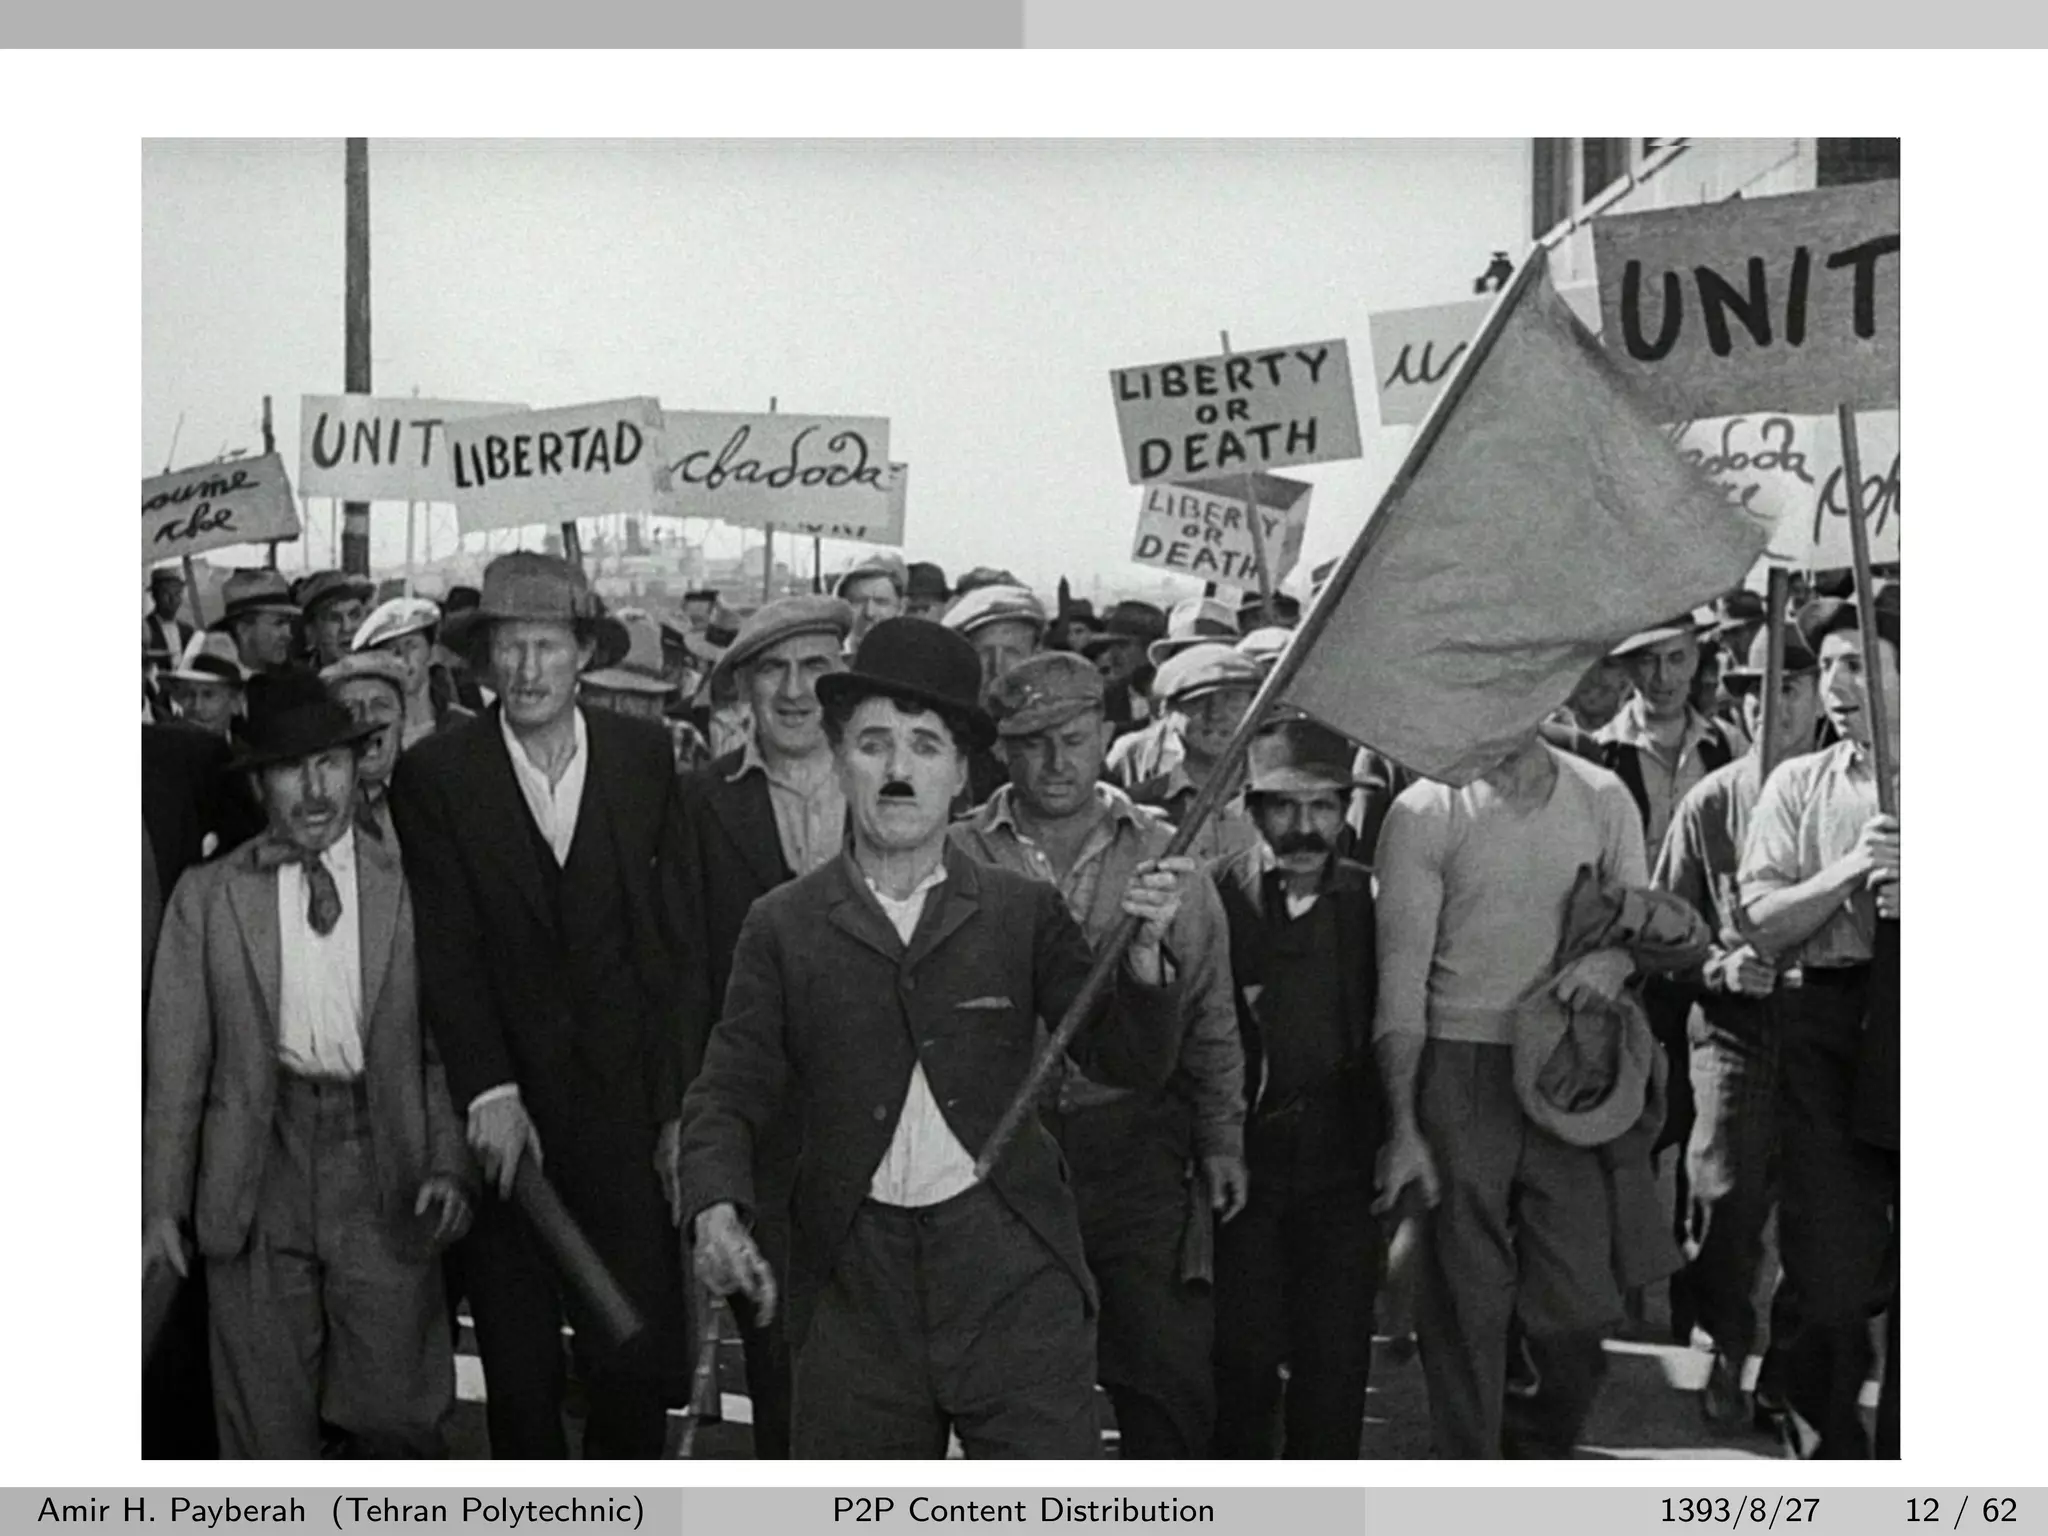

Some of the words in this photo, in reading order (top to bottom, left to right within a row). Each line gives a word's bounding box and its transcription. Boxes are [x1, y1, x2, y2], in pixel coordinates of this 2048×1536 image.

[1620, 234, 1900, 361] UNIT
[1118, 348, 1327, 400] LIBERTY
[1196, 398, 1250, 425] OR
[311, 412, 443, 470] UNIT
[453, 420, 643, 488] LIBERTAD
[1140, 416, 1317, 480] DEATH
[1147, 488, 1280, 538] LIBERY
[1181, 523, 1225, 546] OR
[1136, 534, 1261, 580] DEATH
